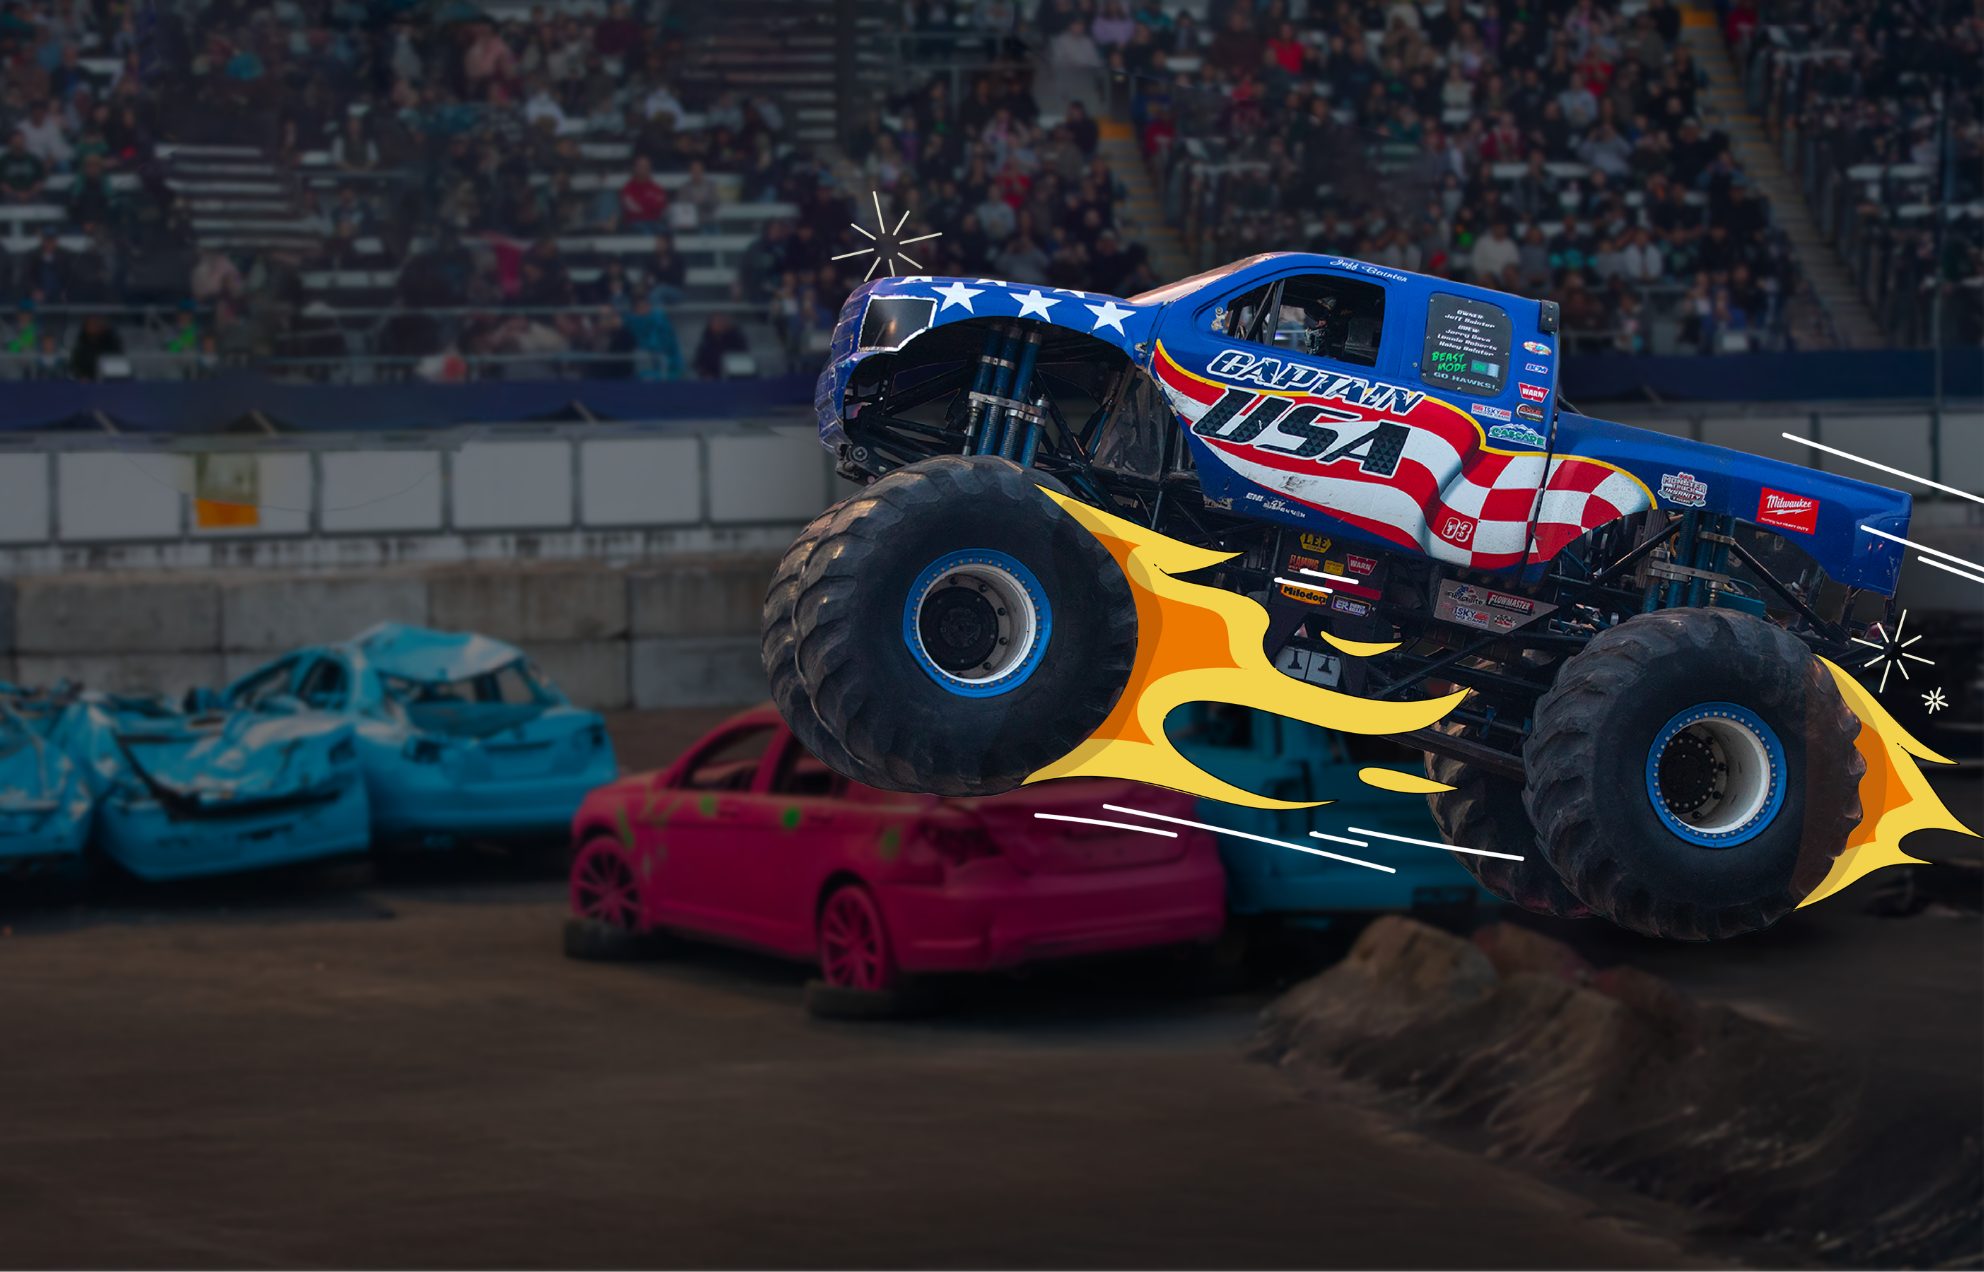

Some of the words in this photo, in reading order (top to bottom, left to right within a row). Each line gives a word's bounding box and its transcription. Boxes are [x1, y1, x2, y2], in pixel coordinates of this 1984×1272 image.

[1329, 259, 1359, 271] Jeff
[1444, 313, 1463, 322] Jeff
[1464, 339, 1498, 351] Roberts
[1431, 351, 1465, 363] BEAST
[1437, 363, 1468, 373] MODE
[1473, 363, 1487, 371] ON
[1206, 349, 1426, 416] CAPTAIN
[1433, 371, 1449, 379] GO
[1452, 375, 1496, 390] HAWKS!
[1521, 388, 1544, 398] WARN
[1520, 406, 1542, 415] AXLE
[1190, 386, 1412, 479] USA
[1491, 427, 1545, 446] CASCADE
[1663, 475, 1706, 492] MONSTER
[1765, 494, 1812, 509] Milwaukee
[1442, 517, 1473, 542] 03
[1303, 534, 1328, 549] LEE
[1350, 559, 1372, 571] WARN
[1488, 594, 1531, 612] FLOWMASTER
[1454, 606, 1476, 617] ISKY
